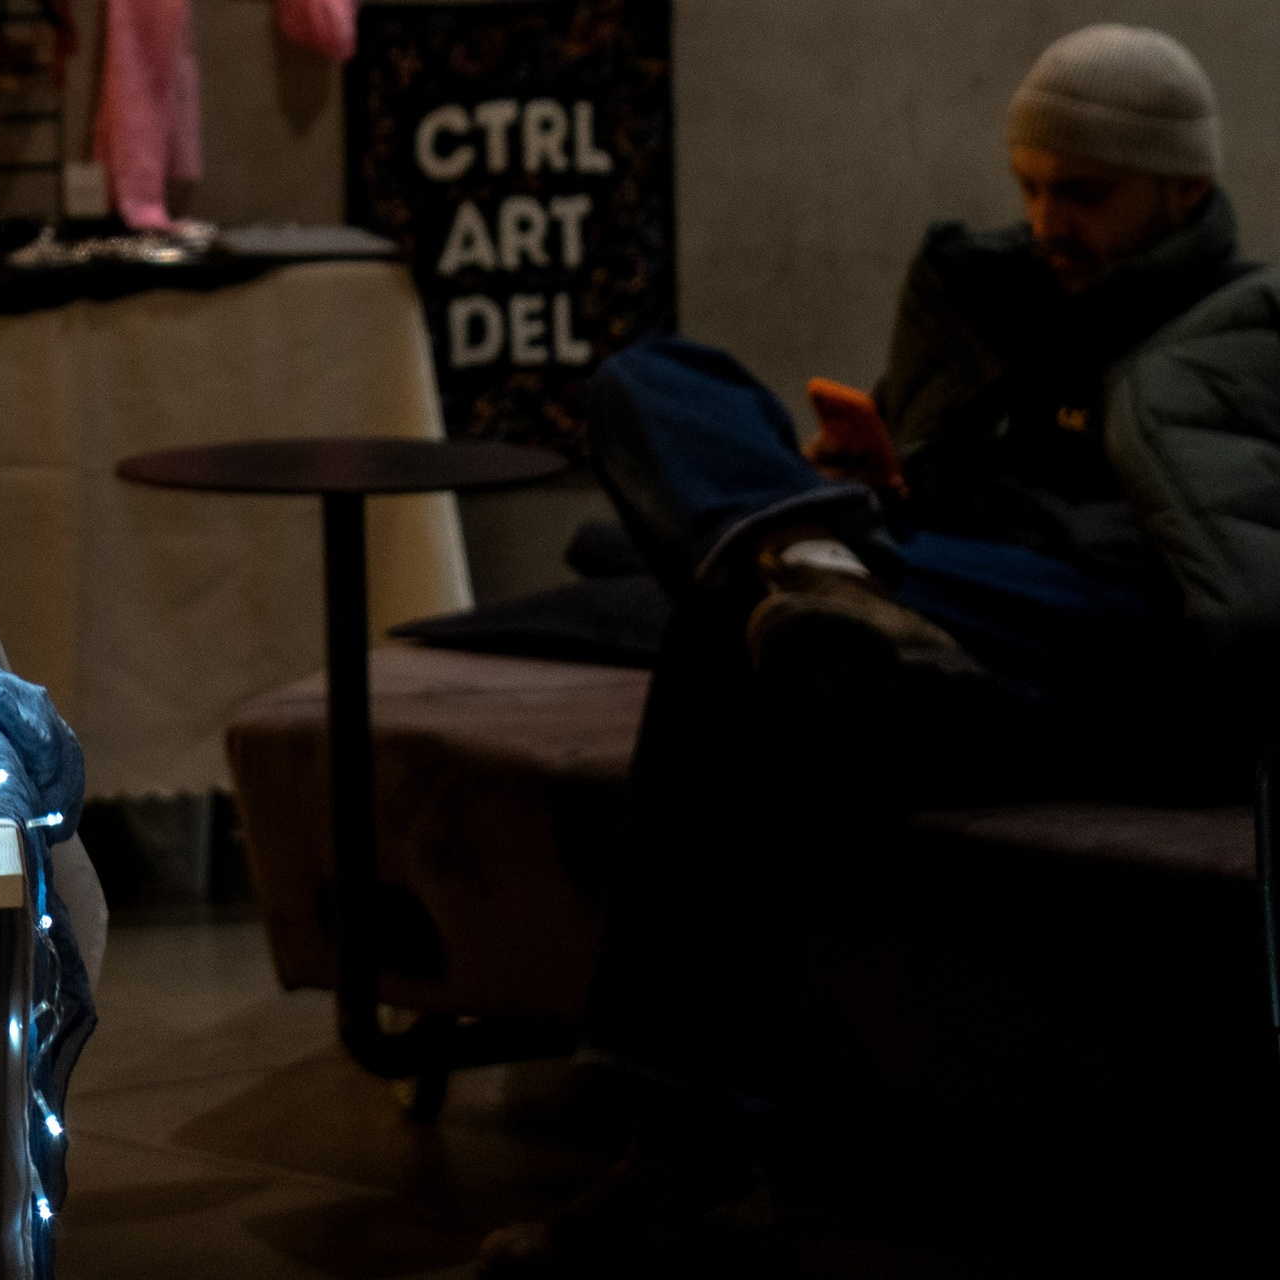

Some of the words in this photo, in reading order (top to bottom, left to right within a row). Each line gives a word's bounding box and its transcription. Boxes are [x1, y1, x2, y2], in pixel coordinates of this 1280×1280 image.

[414, 98, 613, 181] CTRL
[437, 193, 592, 276] ART
[447, 292, 592, 368] DEL
